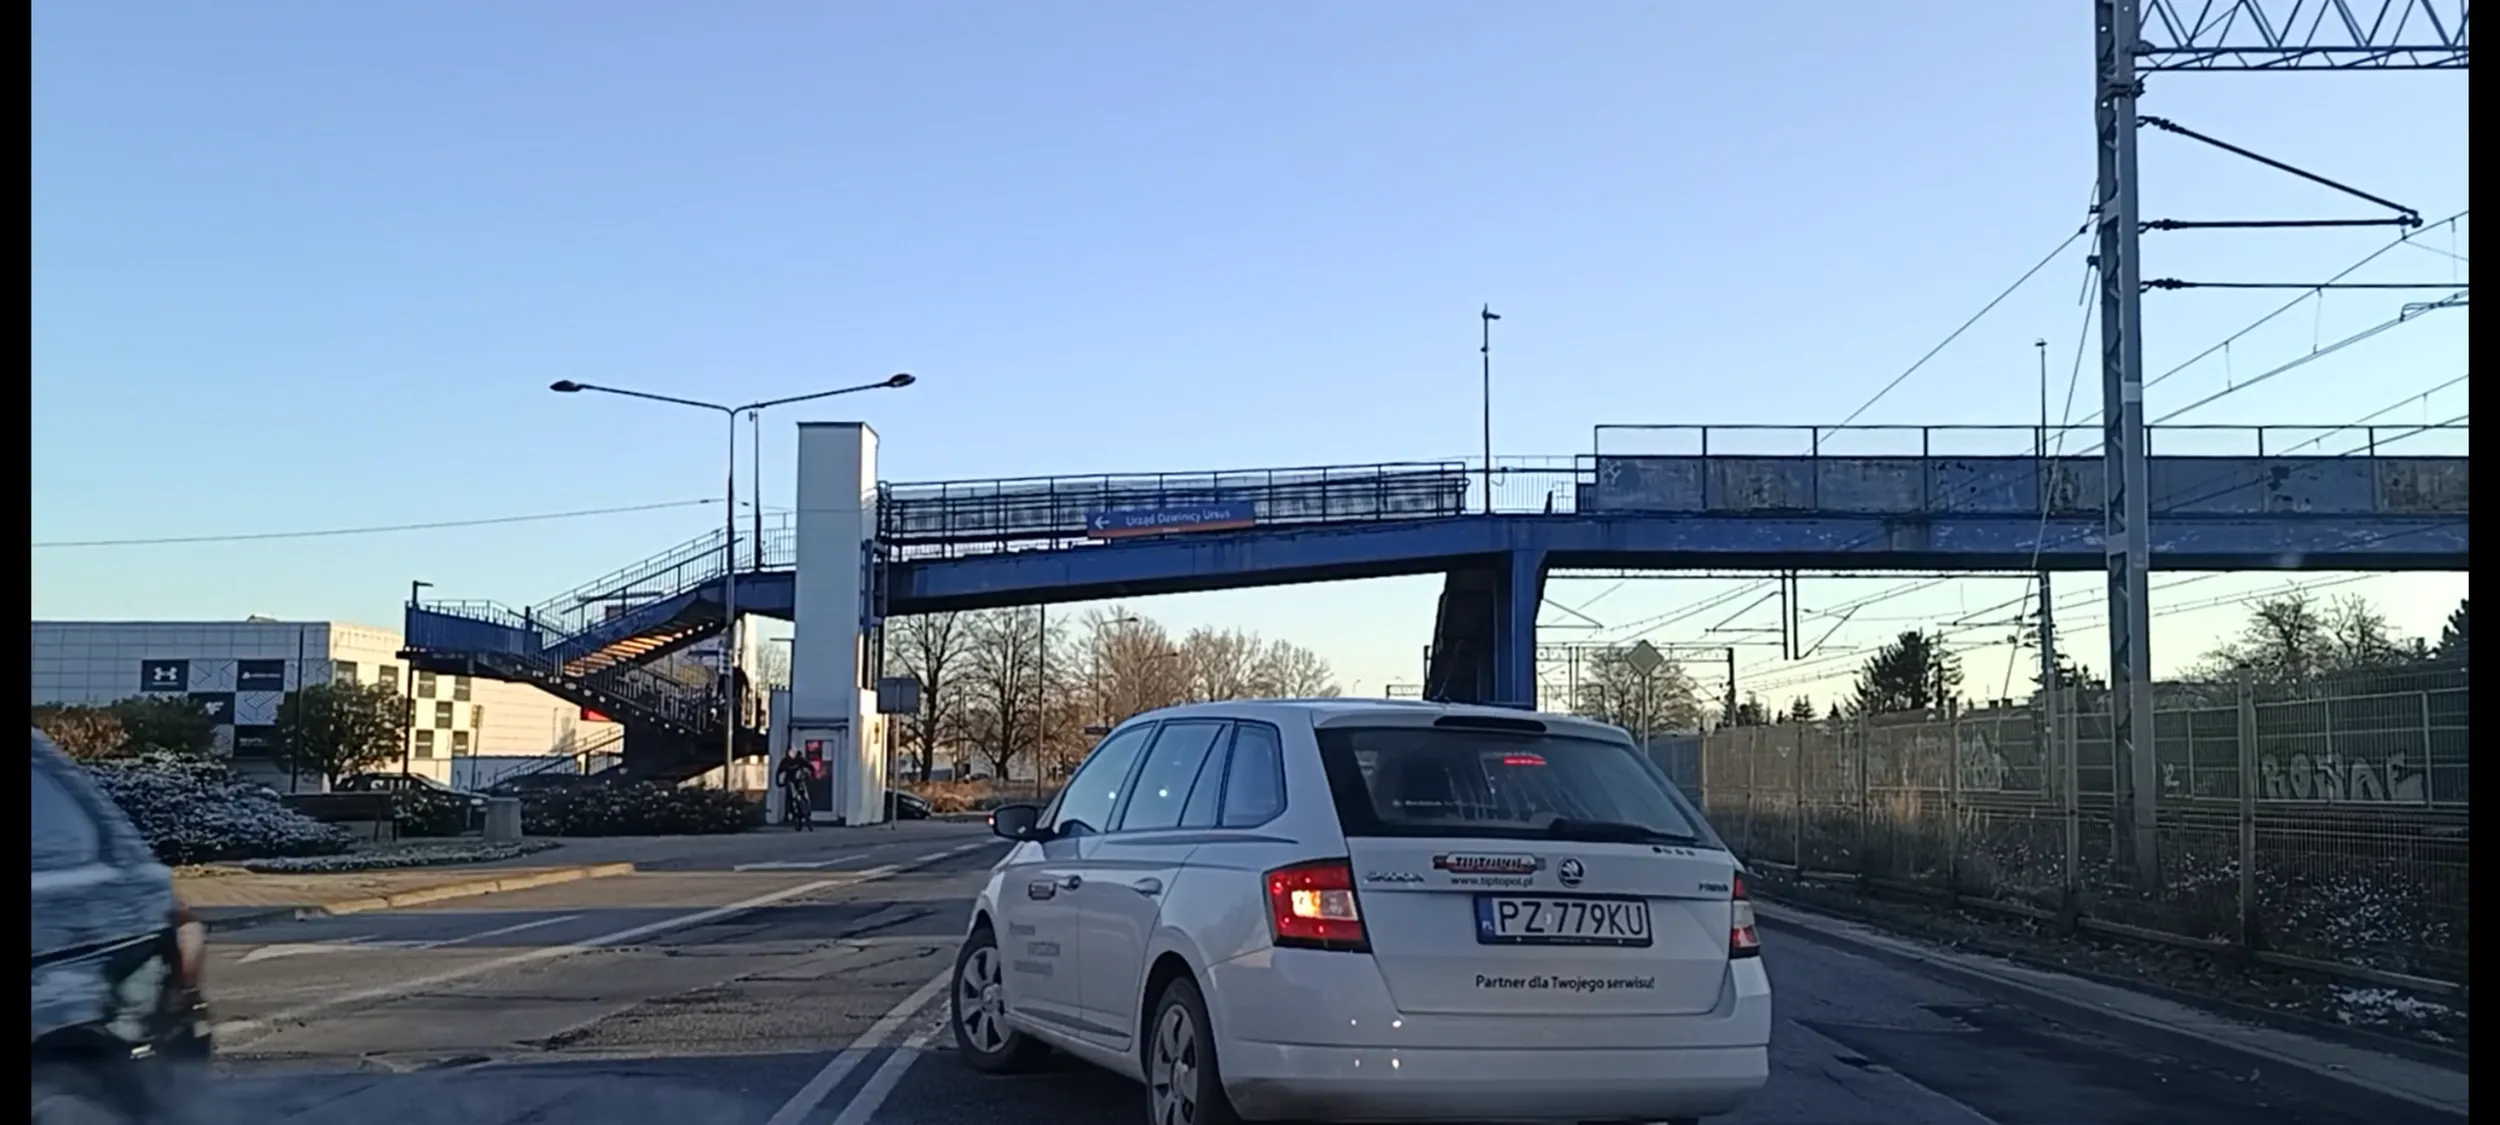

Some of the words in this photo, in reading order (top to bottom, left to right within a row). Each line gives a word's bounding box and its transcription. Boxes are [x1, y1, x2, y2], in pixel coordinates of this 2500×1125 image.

[1202, 508, 1231, 520] Ursus
[1451, 876, 1534, 888] www.tiptopol.pl
[1498, 901, 1545, 933] PZ
[1552, 902, 1644, 936] 779KU
[1476, 974, 1525, 989] Partner
[1528, 975, 1549, 989] dla
[1552, 976, 1605, 993] Twojego
[1607, 976, 1656, 990] serwisu!
